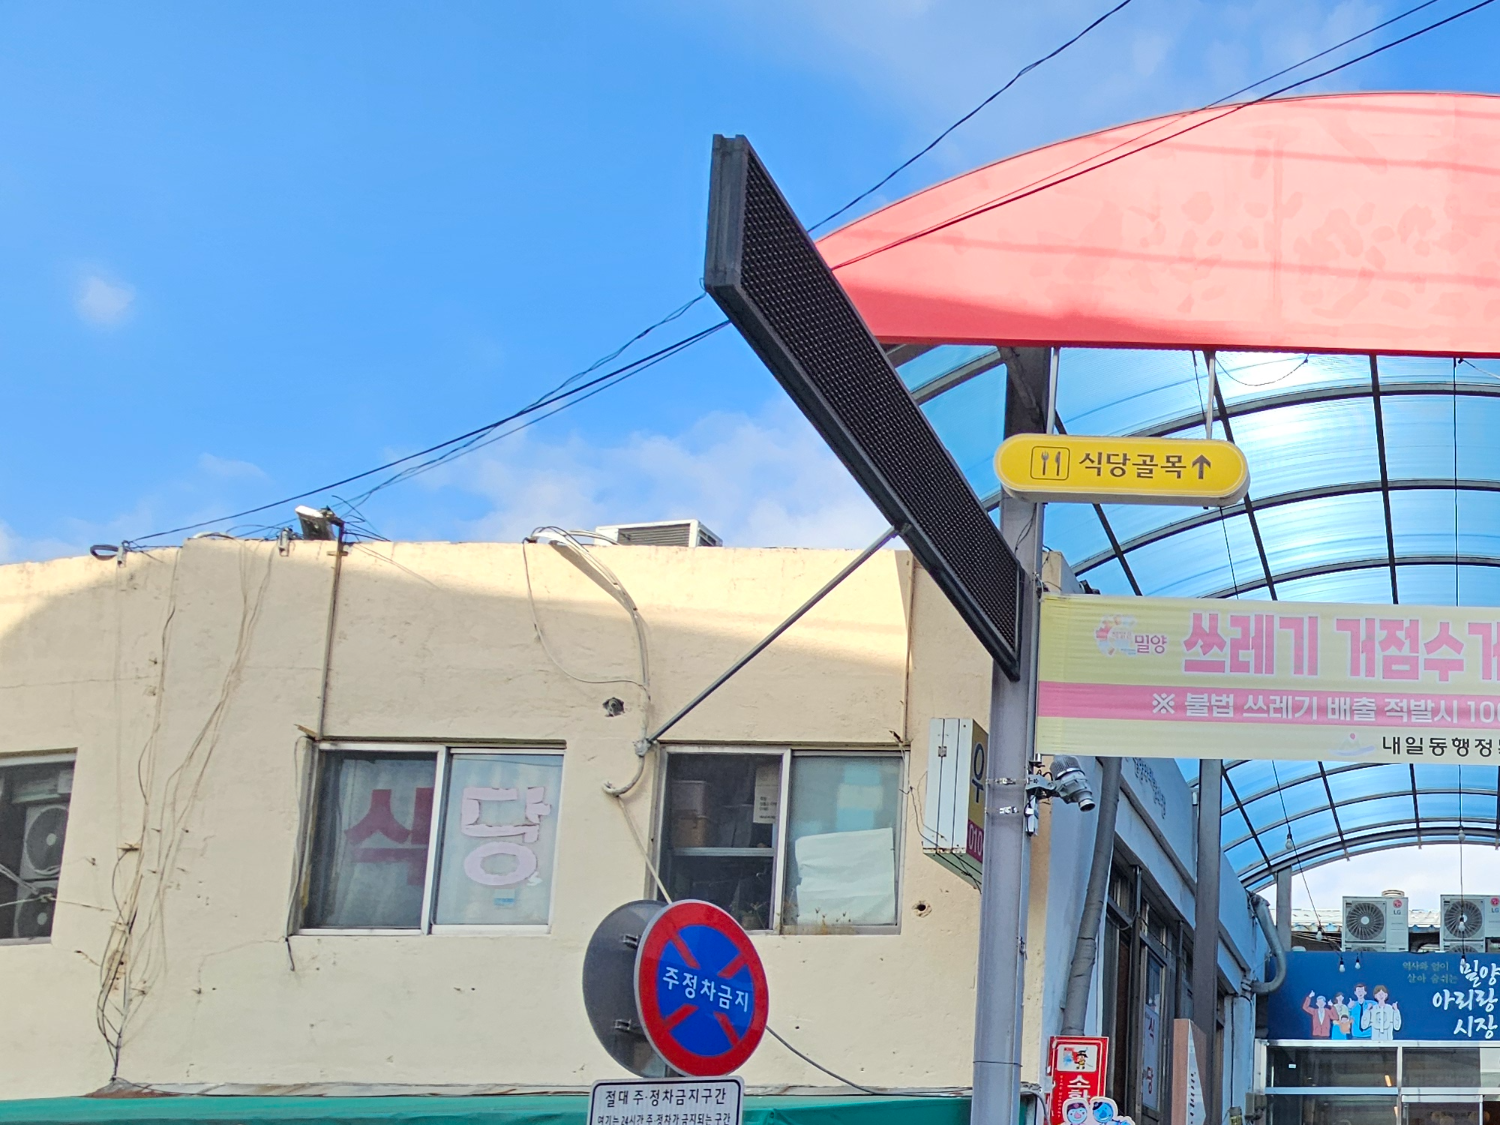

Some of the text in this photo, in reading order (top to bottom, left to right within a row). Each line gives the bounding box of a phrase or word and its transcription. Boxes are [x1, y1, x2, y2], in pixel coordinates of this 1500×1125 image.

[1079, 452, 1187, 480] 식당골목
[1134, 633, 1168, 655] 밀양
[1183, 611, 1320, 677] 쓰레기
[1185, 692, 1235, 718] 불법
[1242, 694, 1318, 721] 쓰레기
[1326, 697, 1377, 722] 배출
[1384, 698, 1458, 724] 적발시
[662, 966, 749, 1013] 주정차금지
[1432, 987, 1499, 1013] 아리랑
[1453, 1014, 1499, 1040] 시장
[605, 1090, 629, 1108] 절대
